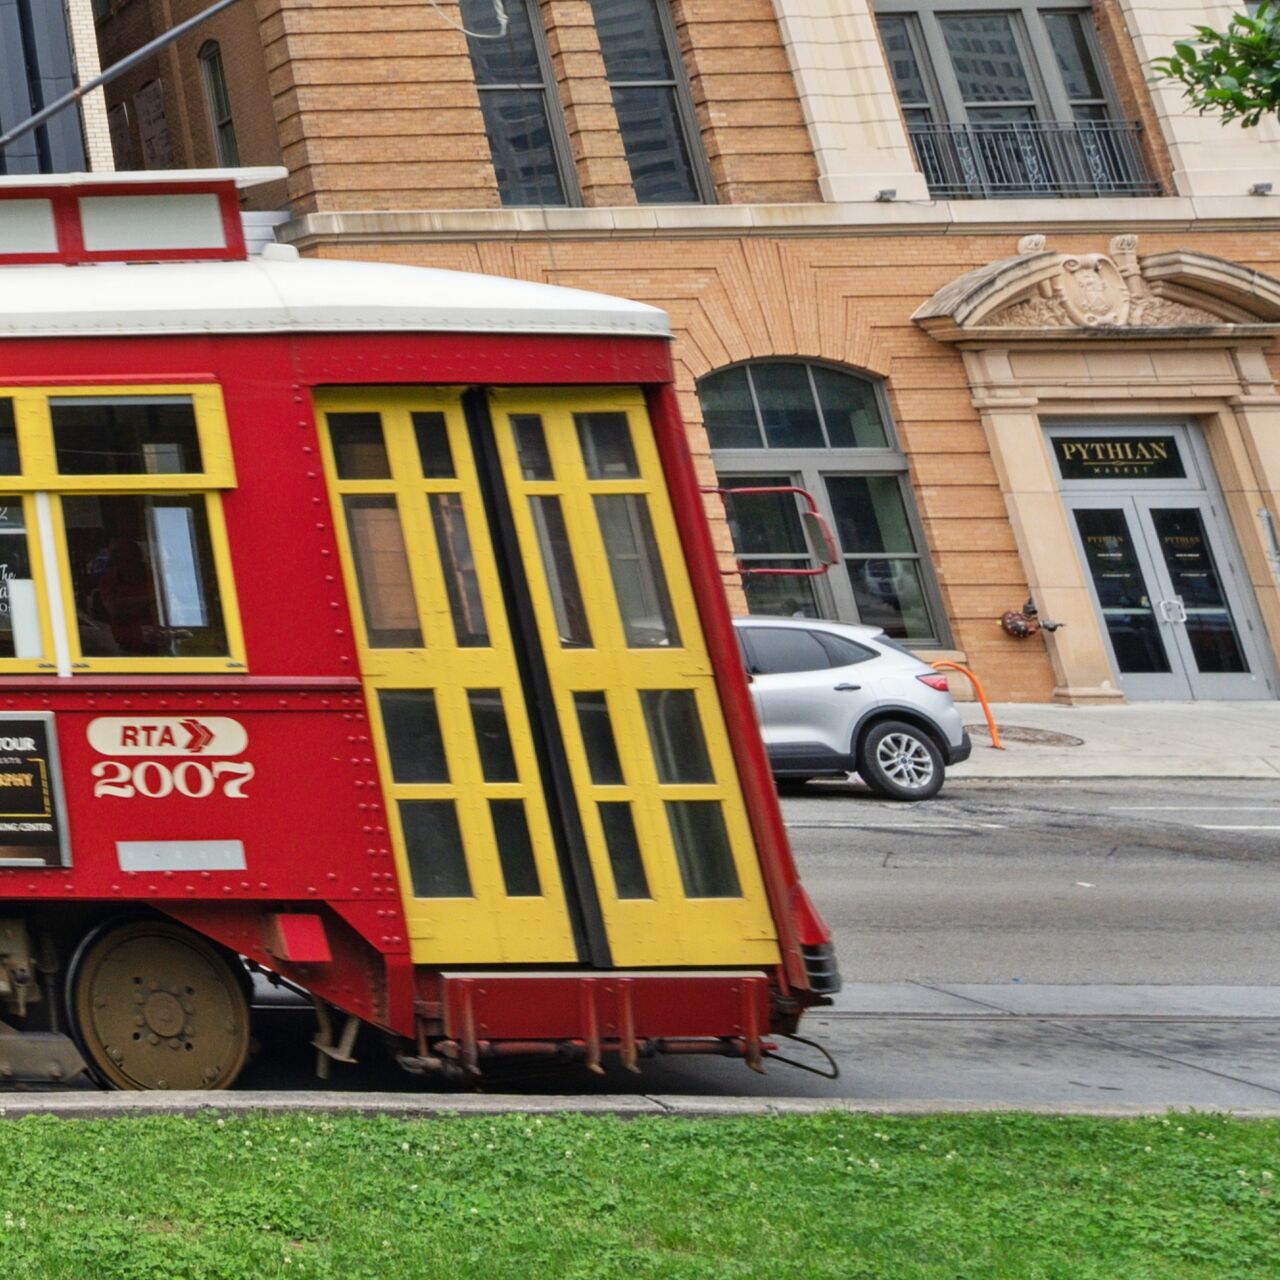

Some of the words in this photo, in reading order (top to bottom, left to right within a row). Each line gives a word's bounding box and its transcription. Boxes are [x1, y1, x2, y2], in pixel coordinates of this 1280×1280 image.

[1062, 442, 1168, 460] PYTHIAN
[120, 725, 177, 747] RTA
[91, 761, 255, 798] 2007
